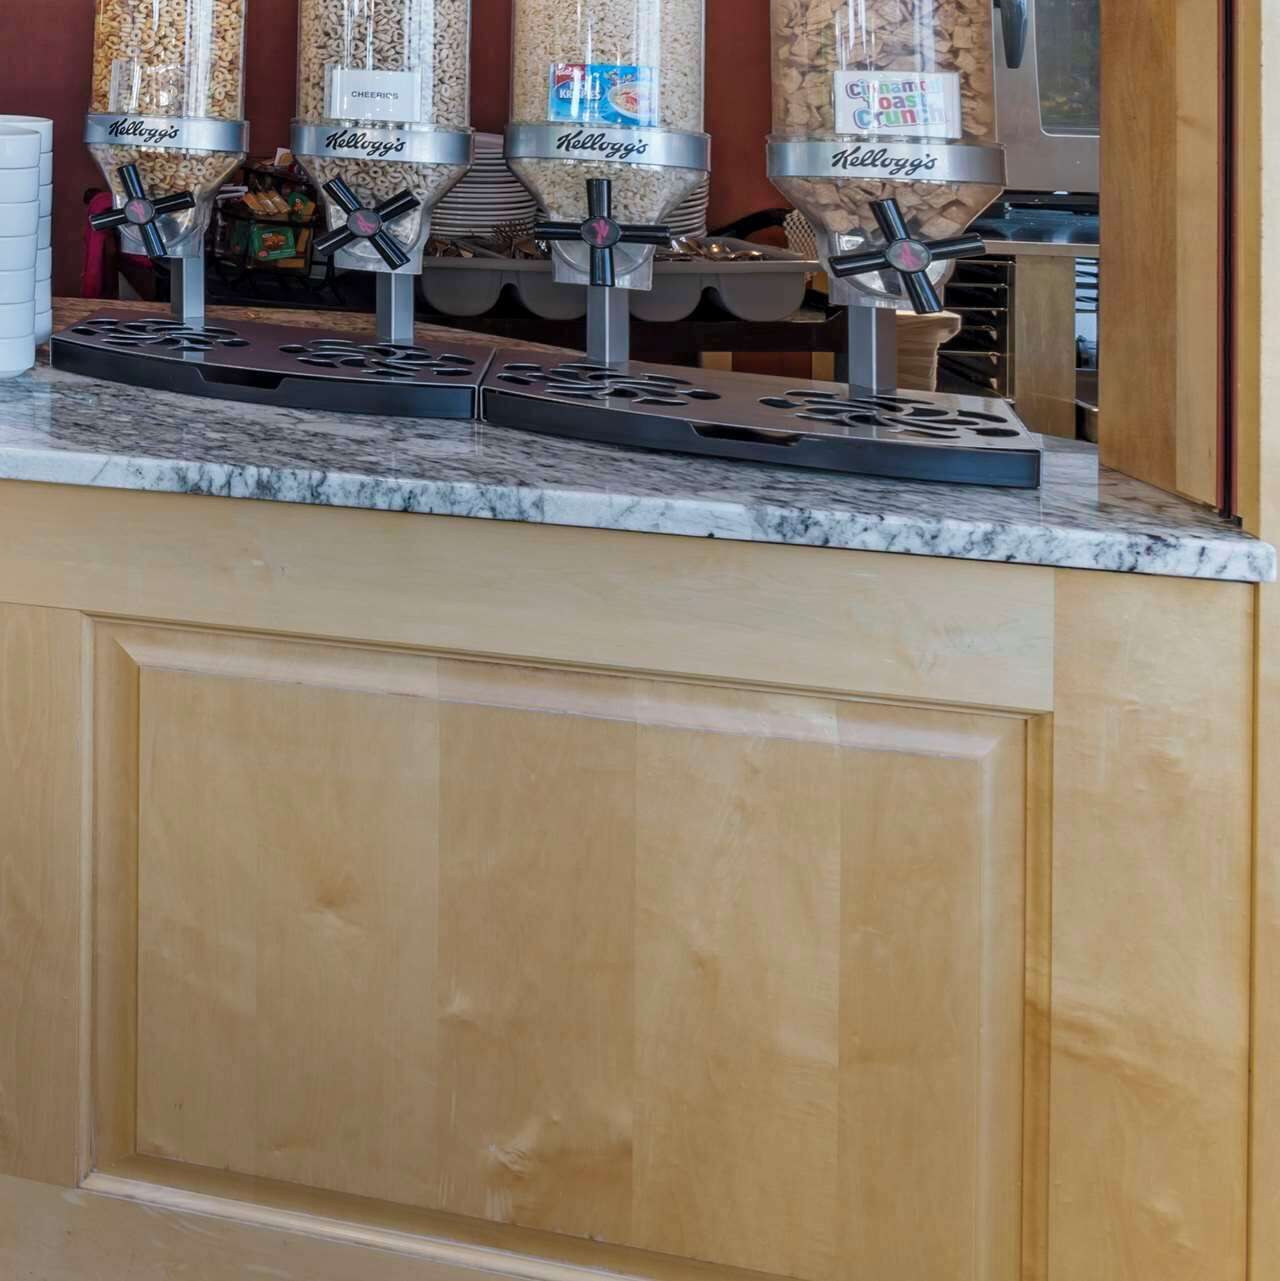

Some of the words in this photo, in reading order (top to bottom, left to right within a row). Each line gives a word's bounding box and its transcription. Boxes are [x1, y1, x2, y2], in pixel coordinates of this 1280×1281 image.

[351, 91, 399, 100] CHEERIOS
[108, 118, 180, 143] Kellogg's
[325, 129, 406, 157] Kellogg's
[556, 130, 648, 159] Kellogg's
[831, 146, 938, 176] Kellogg's
